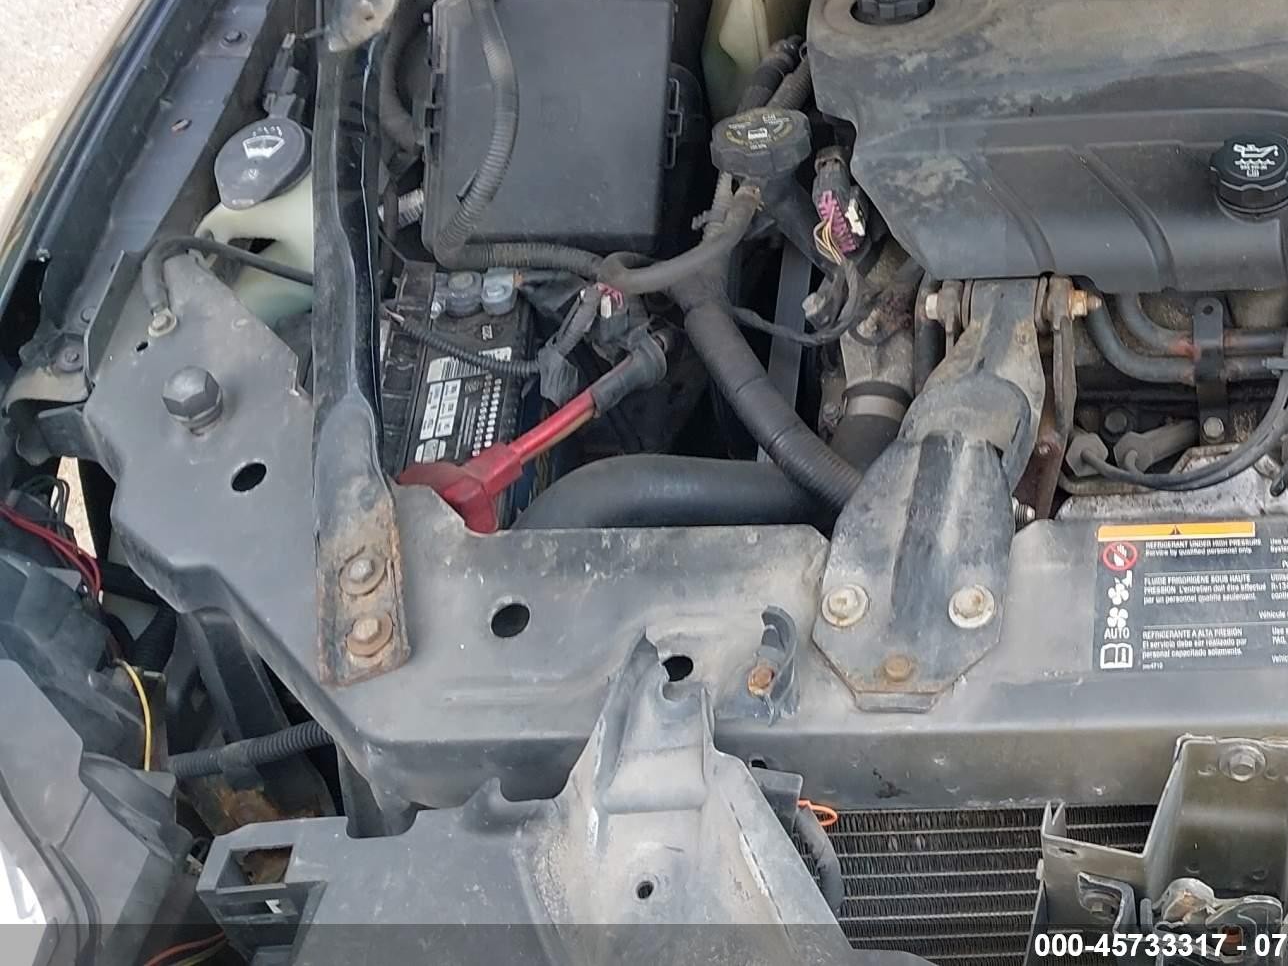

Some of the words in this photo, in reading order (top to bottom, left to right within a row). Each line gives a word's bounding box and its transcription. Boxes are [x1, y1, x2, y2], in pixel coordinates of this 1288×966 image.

[1146, 540, 1188, 548] REFRIGERANT
[1166, 595, 1196, 604] personnel
[1104, 628, 1129, 639] AUTO
[1142, 630, 1191, 639] REFRIGERANTE
[1192, 630, 1197, 638] A
